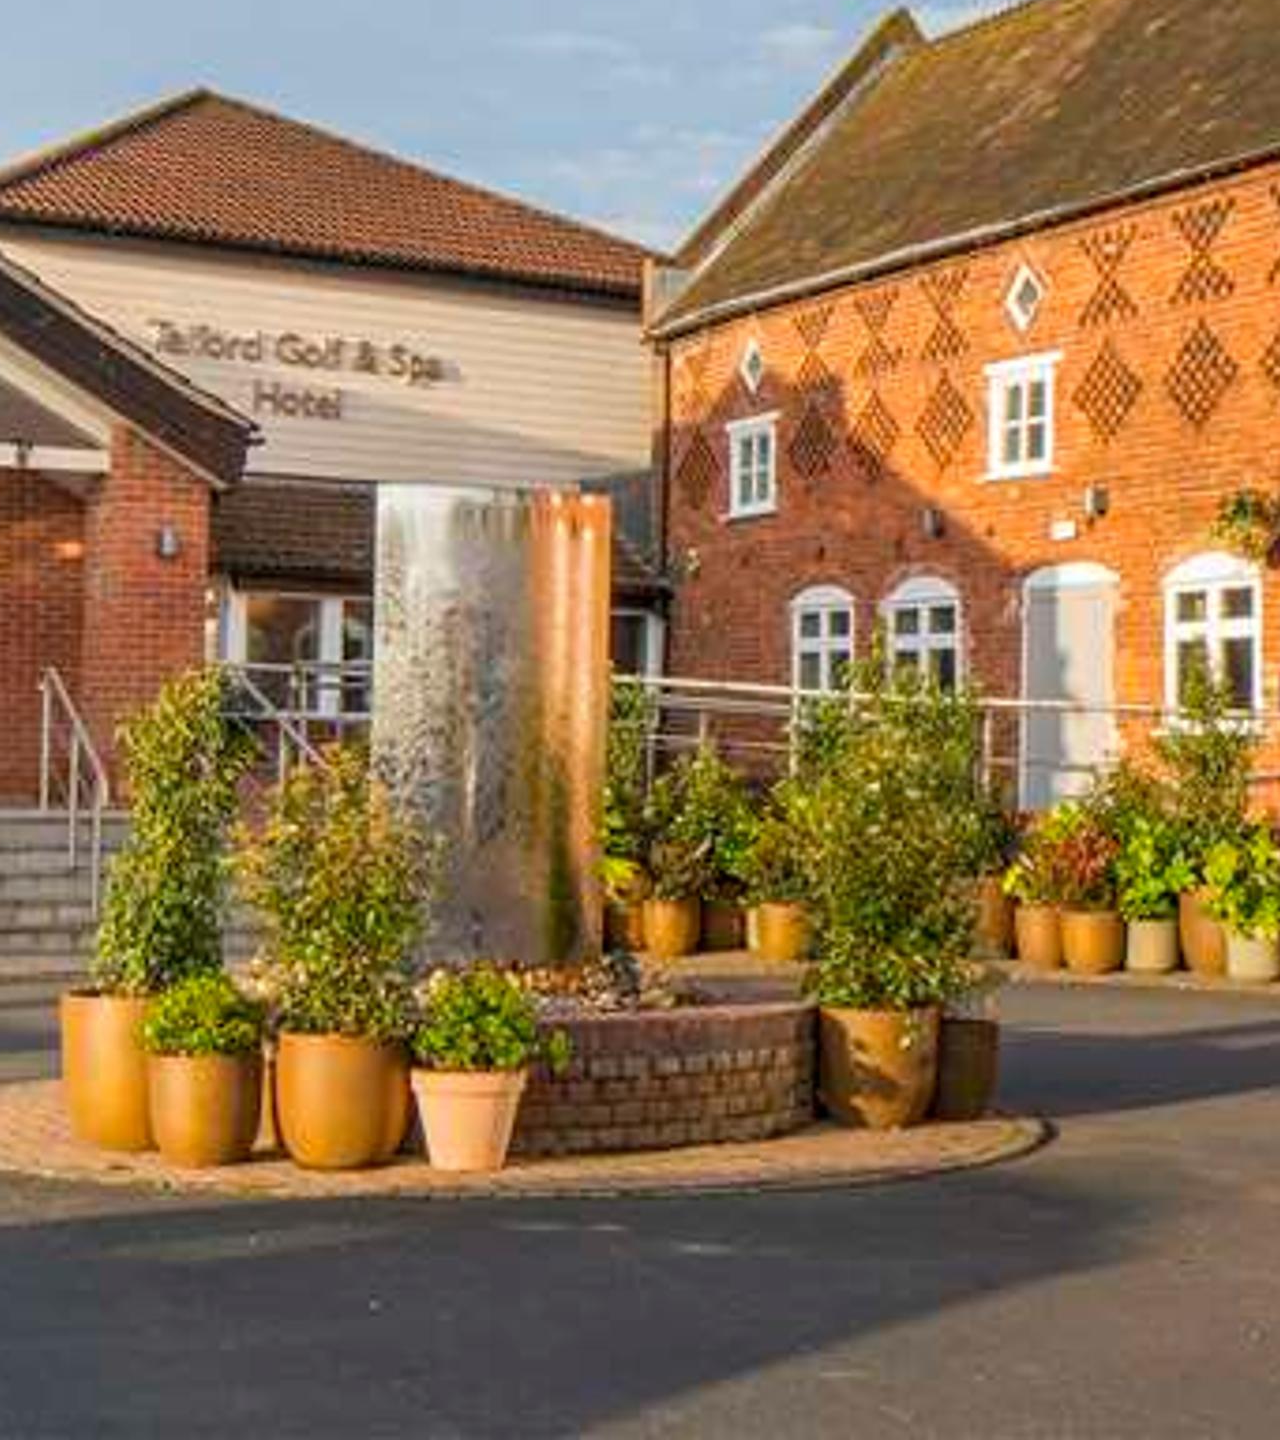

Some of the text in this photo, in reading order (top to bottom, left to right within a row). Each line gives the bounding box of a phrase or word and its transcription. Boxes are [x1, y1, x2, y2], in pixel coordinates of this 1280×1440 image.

[274, 331, 345, 368] Golf
[352, 339, 378, 374] &
[387, 342, 449, 388] Spa
[252, 377, 342, 420] Hotel
